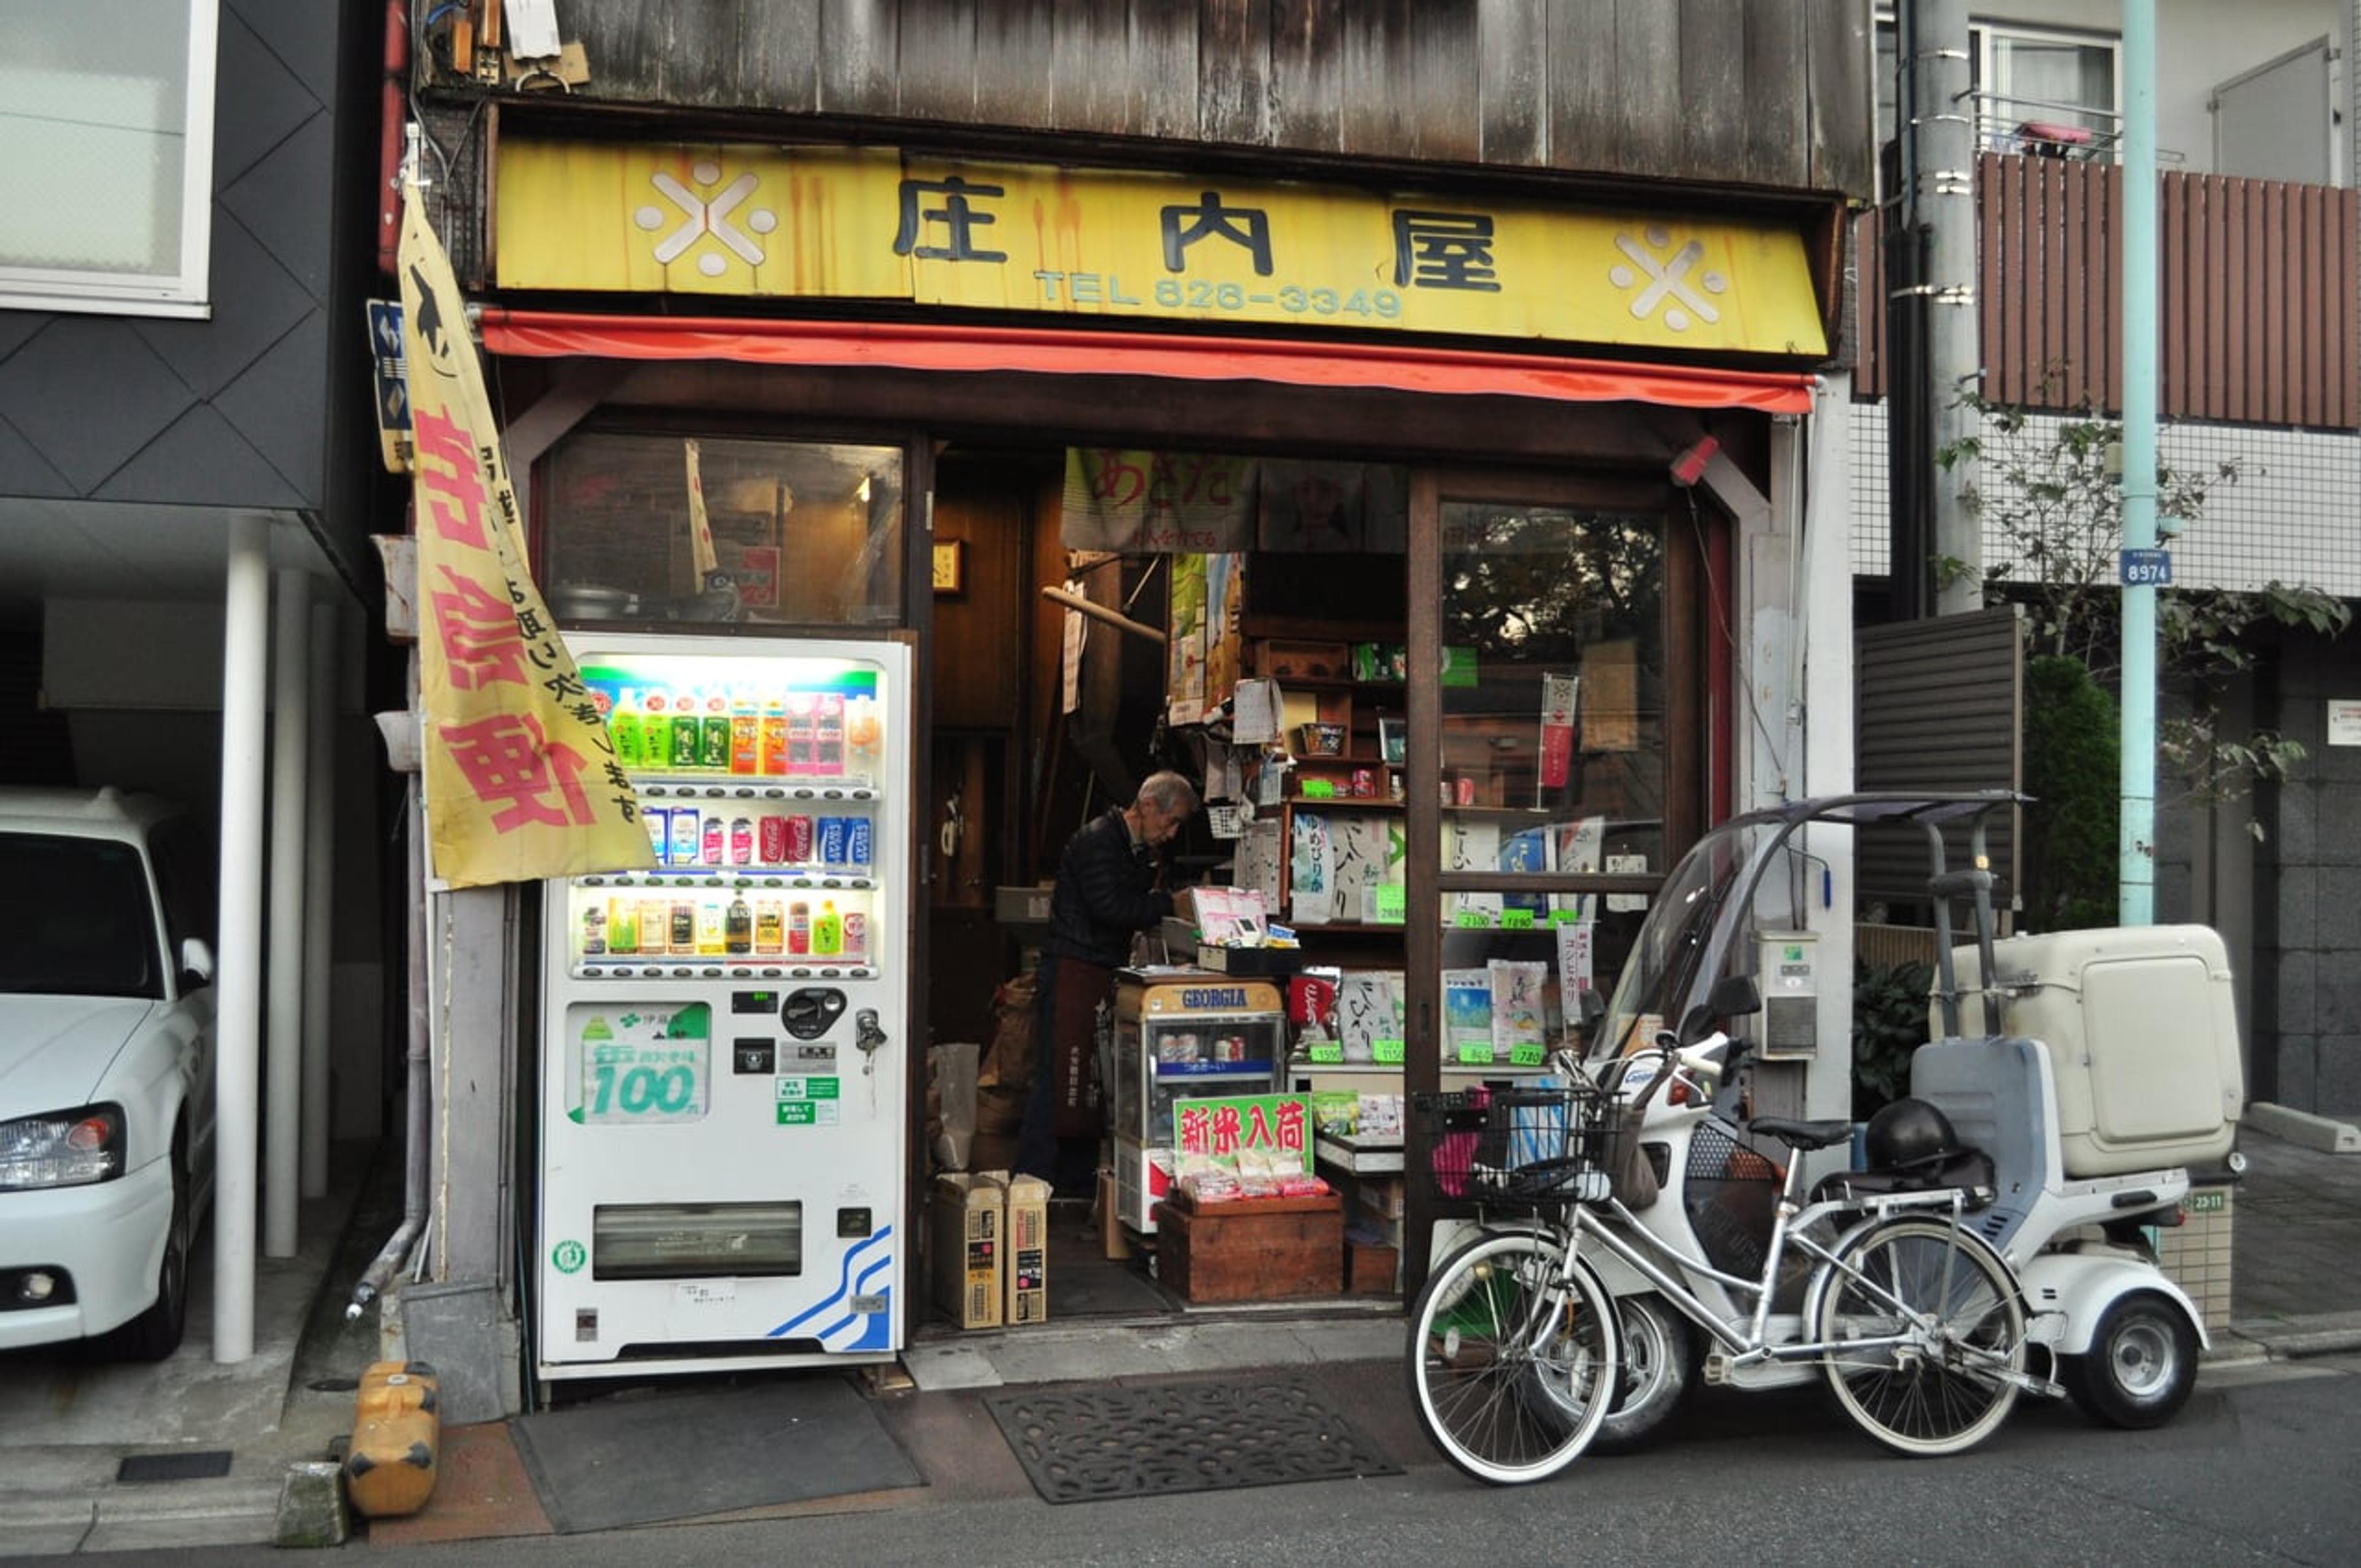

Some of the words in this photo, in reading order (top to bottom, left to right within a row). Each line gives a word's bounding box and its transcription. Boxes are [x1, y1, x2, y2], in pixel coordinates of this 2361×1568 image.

[893, 176, 1501, 292] 庄内屋
[1034, 271, 1141, 306] TEL
[1154, 279, 1401, 317] 828-3349
[2128, 564, 2166, 581] 8974
[1565, 939, 1576, 1004] コシヒカリ
[1182, 988, 1248, 1008] GEORGIA
[1180, 1101, 1305, 1157] 新米入荷
